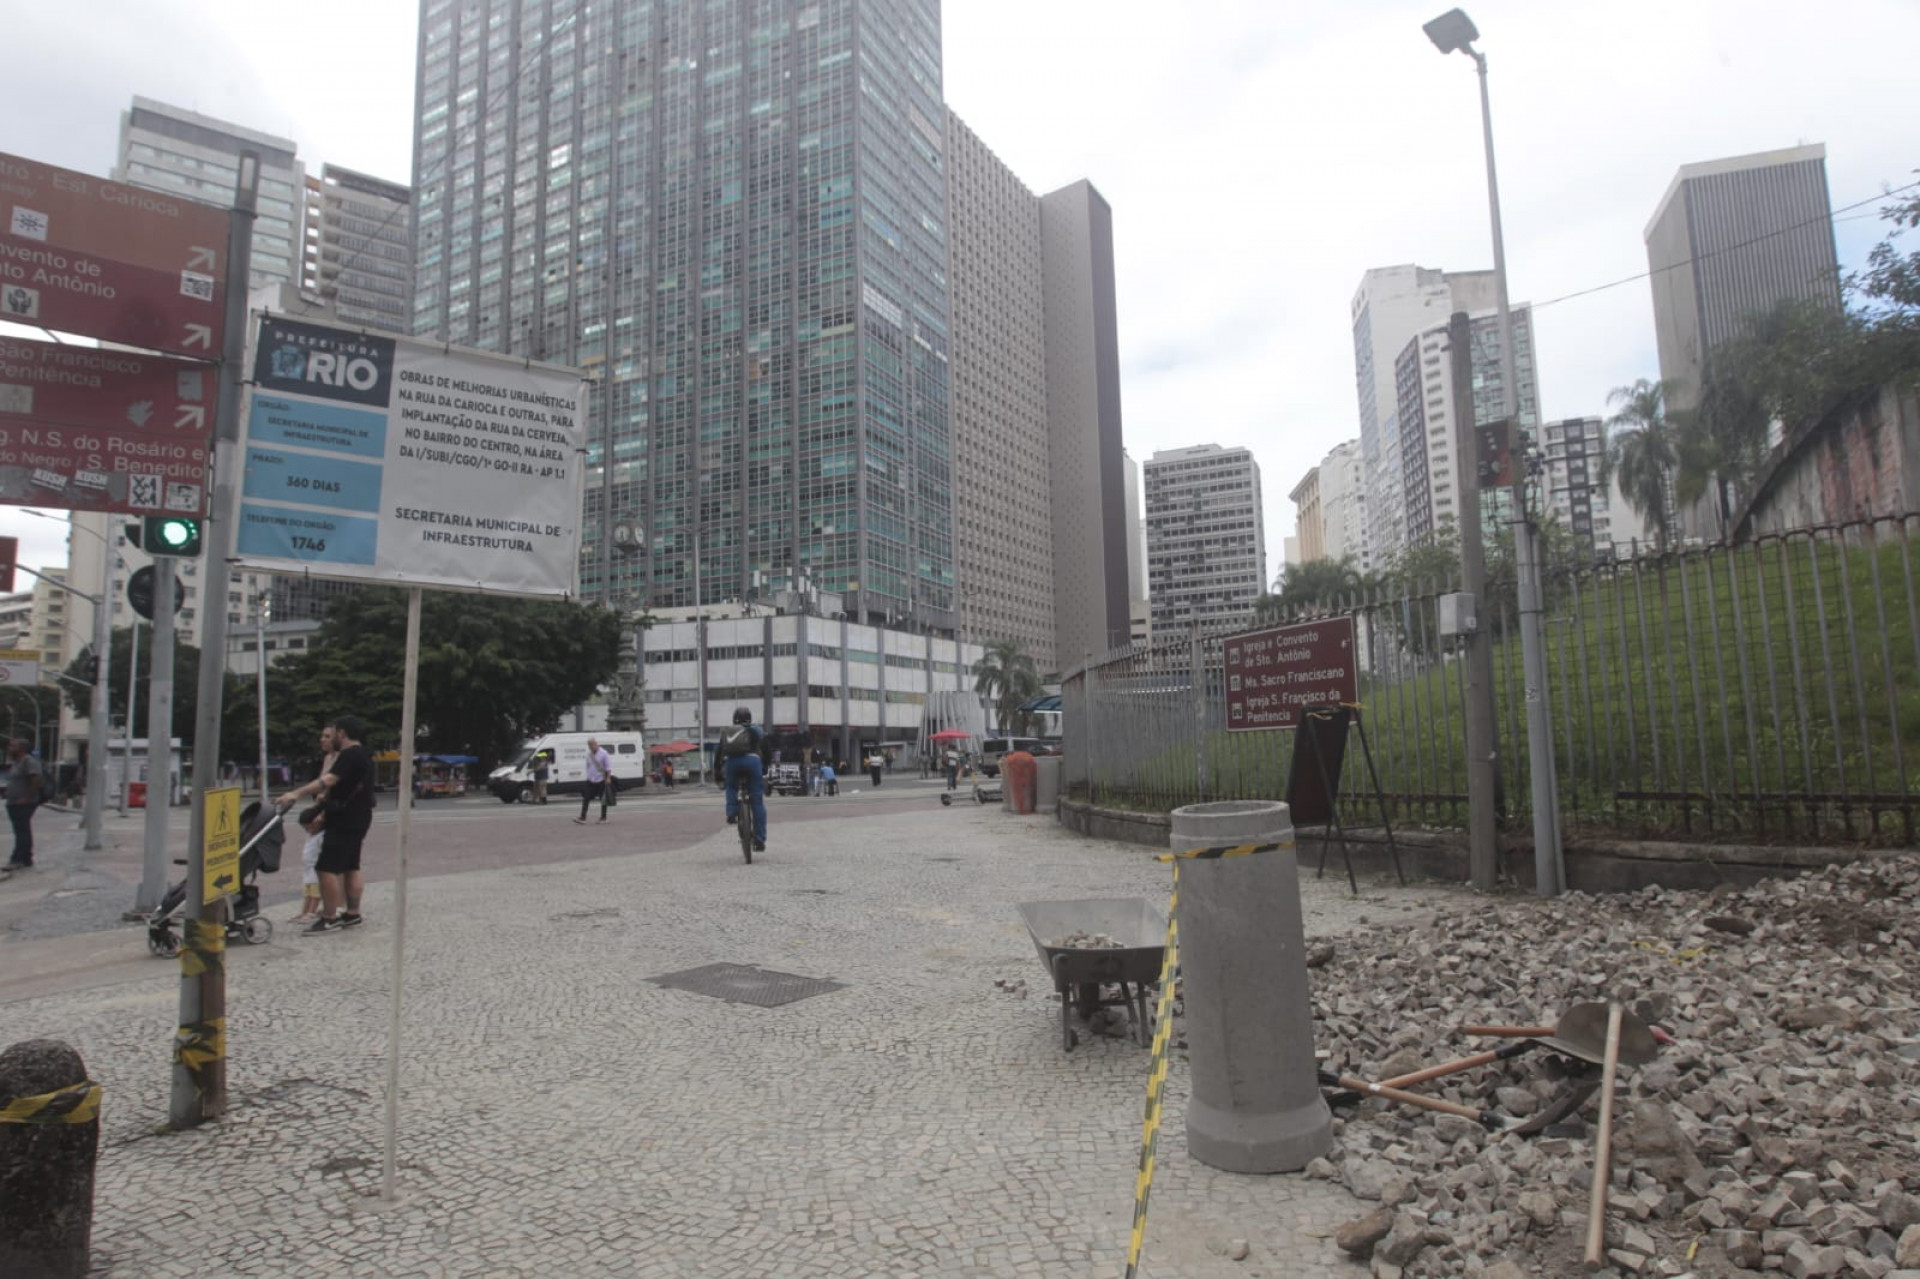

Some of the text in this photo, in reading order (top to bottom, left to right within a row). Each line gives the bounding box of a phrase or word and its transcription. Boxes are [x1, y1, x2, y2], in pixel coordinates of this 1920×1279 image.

[100, 184, 180, 217] Carioca
[75, 259, 102, 278] de
[32, 268, 116, 299] Antônio
[275, 331, 379, 357] PREFEITURA
[42, 346, 142, 375] Francisco
[306, 350, 378, 391] RIO
[400, 370, 576, 411] OBRAS DE MELHORIAS URBANÍSTICAS
[399, 388, 574, 428] NA RUA DA CARIOCA E OUTRAS, PARA
[268, 416, 314, 430] SECRETARIA
[402, 407, 570, 447] IMPLANTAÇÃO DA RUA DA CERVEJA,
[21, 428, 68, 449] N.S.
[73, 435, 99, 451] do
[107, 436, 186, 459] Rosário
[192, 448, 204, 460] e
[283, 430, 352, 446] INFRAESTRUTURA
[405, 427, 564, 461] NO BAIRRO DO CENTRO, NA ÁREA
[22, 451, 71, 468] Negro
[87, 454, 107, 472] S.
[114, 456, 202, 479] Benedito
[400, 446, 414, 458] DA
[520, 463, 533, 476] RA
[540, 466, 553, 479] AP
[287, 475, 341, 493] 360 DIAS
[289, 518, 302, 527] DO
[395, 507, 562, 537] SECRETARIA MUNICIPAL DE
[291, 536, 326, 552] 1746
[423, 530, 533, 552] INFRAESTRUTURA
[1243, 641, 1265, 655] Igreja
[1276, 631, 1319, 647] Convento
[1245, 648, 1312, 668] de Sto. Antônio
[1245, 666, 1345, 688] Ms. Sacro Franciscano
[1247, 687, 1341, 710] Igreja S. Francisco da
